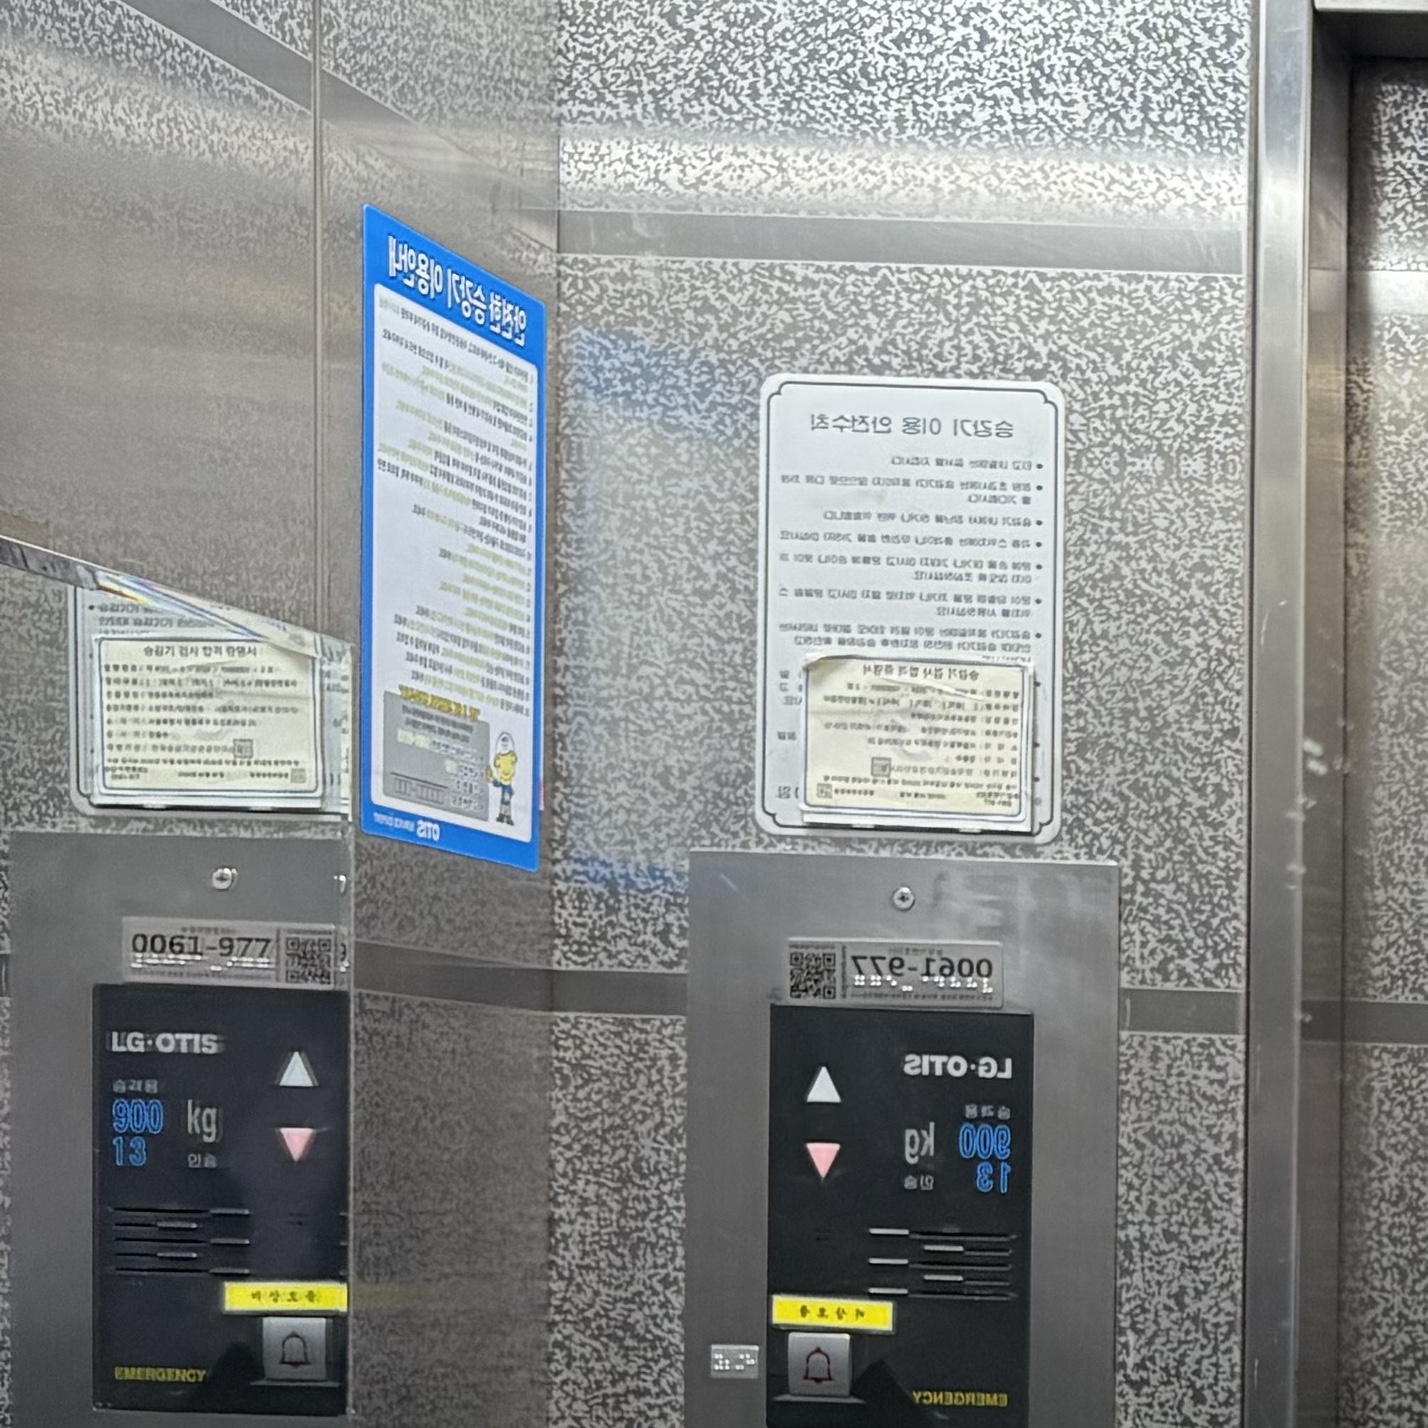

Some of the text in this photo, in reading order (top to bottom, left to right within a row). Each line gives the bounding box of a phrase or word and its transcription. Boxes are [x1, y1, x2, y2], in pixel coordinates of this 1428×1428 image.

[131, 934, 272, 957] 0061-977
[113, 1099, 217, 1142] 900 kg
[113, 1136, 147, 1166] 13
[115, 1367, 207, 1382] EMERGENCY
